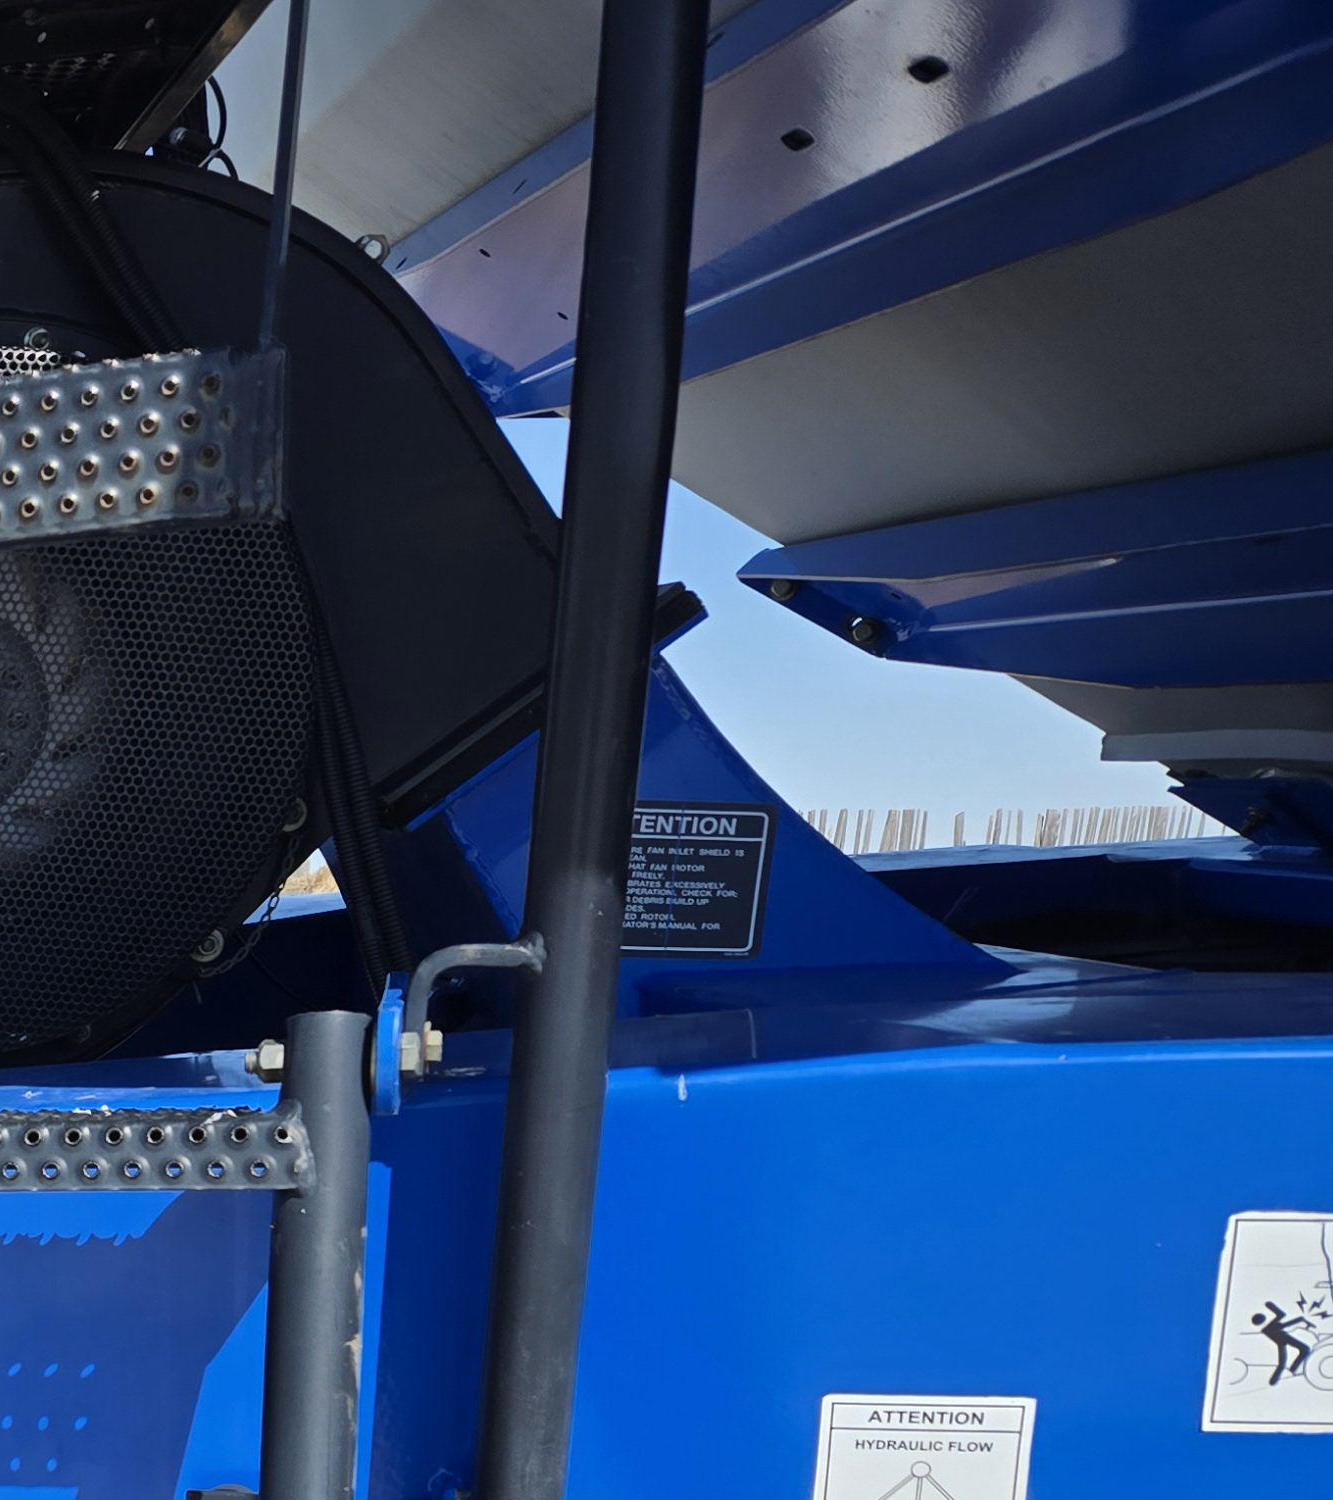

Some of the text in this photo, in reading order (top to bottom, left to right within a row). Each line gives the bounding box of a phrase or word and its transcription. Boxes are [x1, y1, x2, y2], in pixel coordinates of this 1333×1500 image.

[633, 815, 737, 835] ENTION
[647, 847, 665, 855] FAN
[699, 849, 731, 857] SHIELD
[650, 863, 668, 871] FAN
[627, 880, 661, 888] BRATES
[681, 889, 713, 897] CHECK
[701, 922, 721, 930] FOR
[867, 1410, 985, 1425] ATTENTION
[855, 1439, 994, 1452] HYDRAULIC FLOW
